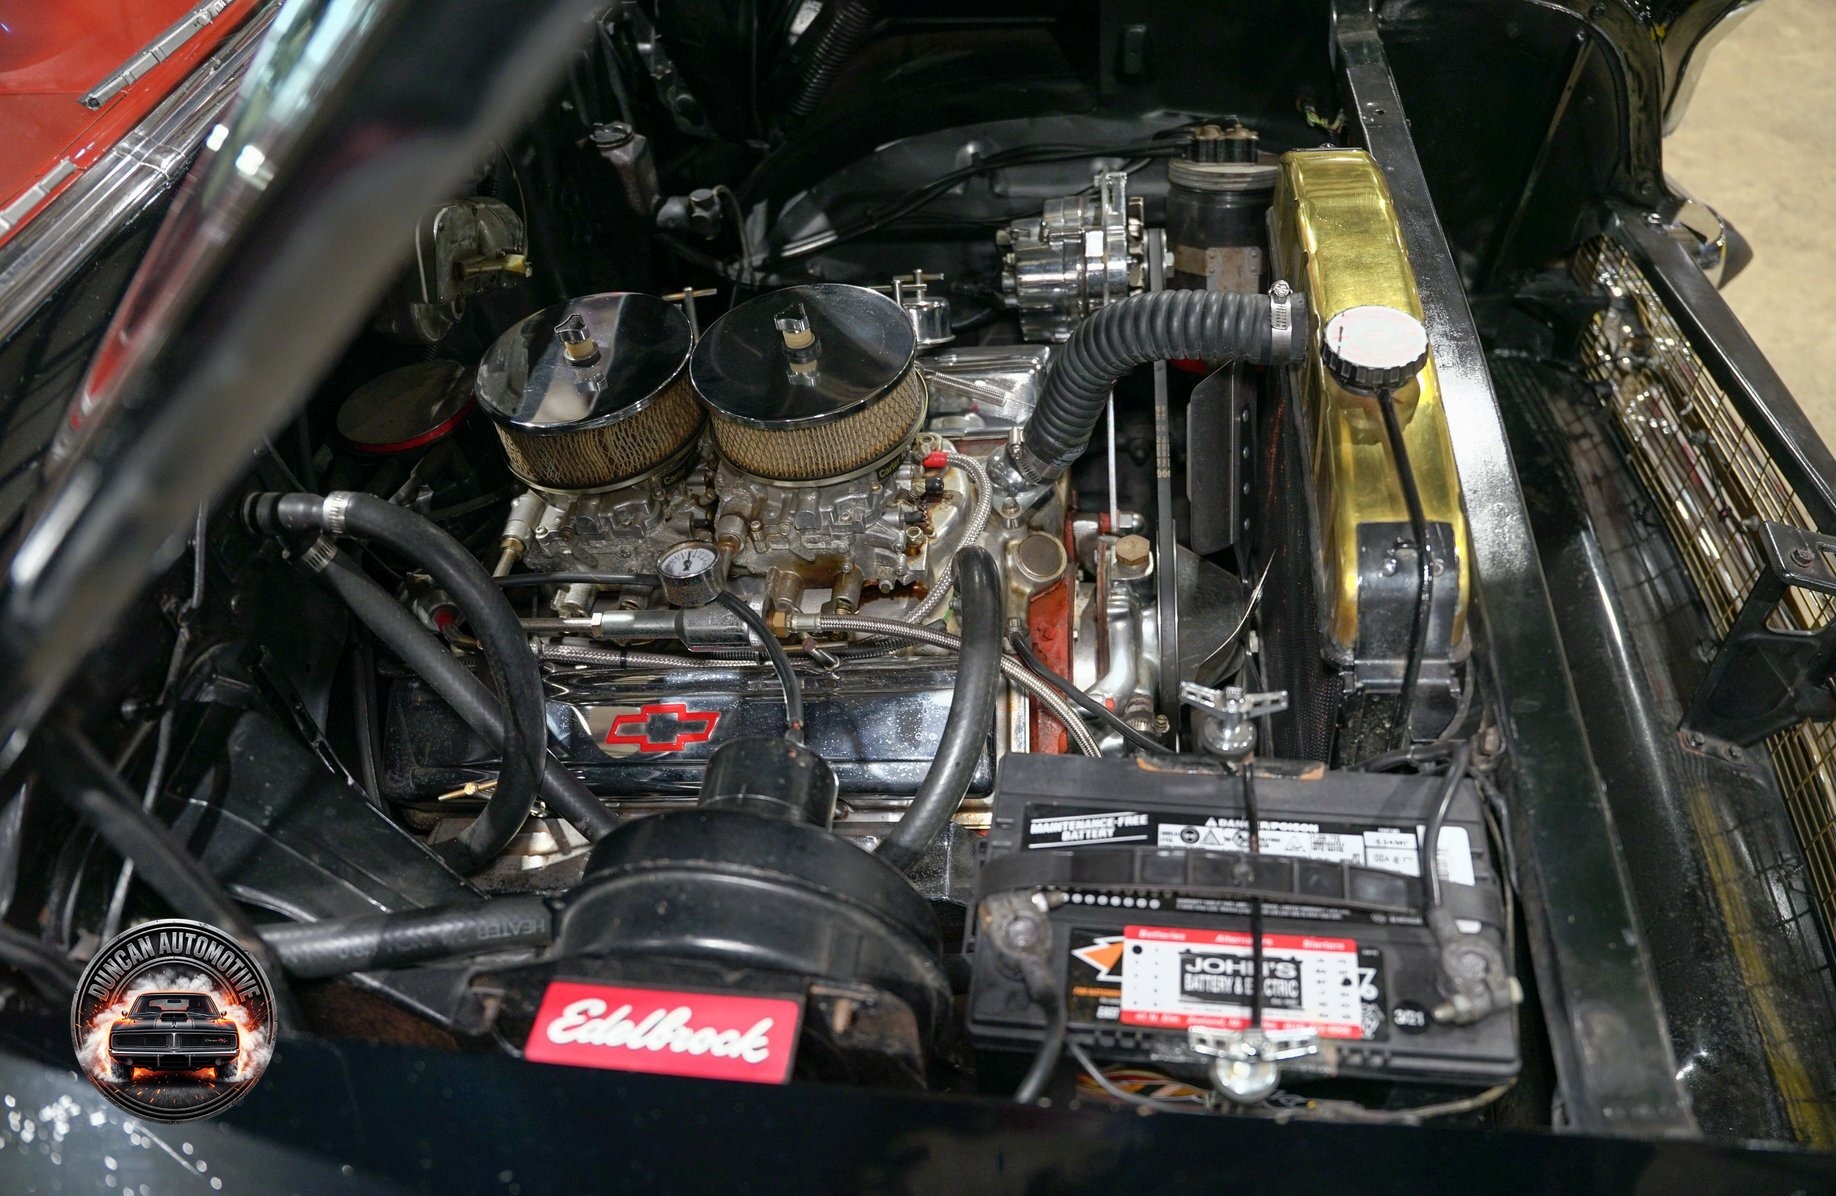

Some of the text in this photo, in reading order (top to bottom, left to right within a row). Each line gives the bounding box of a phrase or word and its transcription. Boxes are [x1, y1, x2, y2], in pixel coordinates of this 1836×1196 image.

[1030, 814, 1149, 834] MAINTENANCE-FREE
[1061, 826, 1116, 842] BATTERY
[1184, 972, 1300, 998] BATTERY & ECTRIC
[546, 997, 774, 1063] Edelbrock
